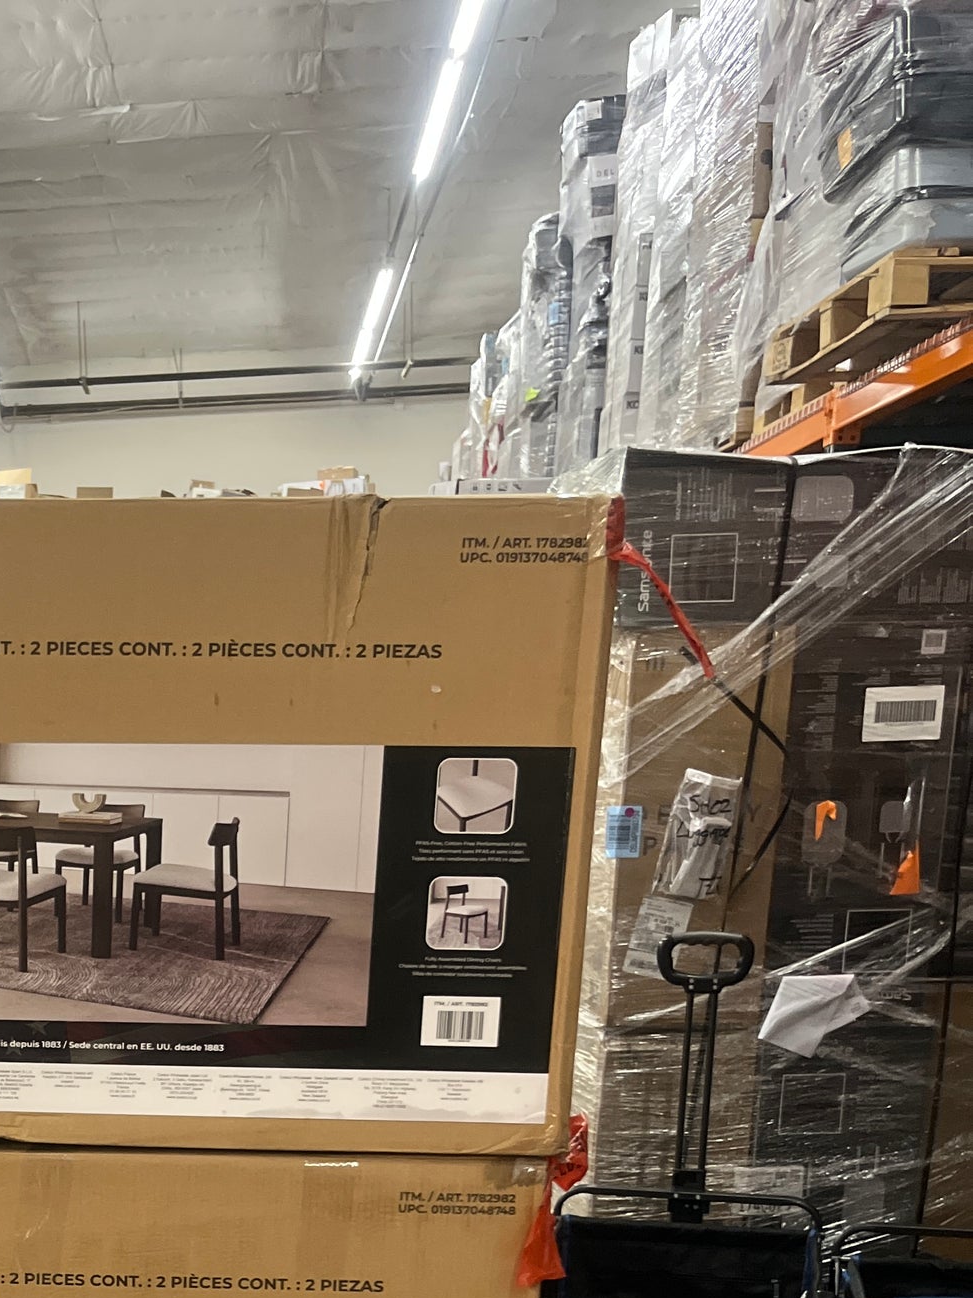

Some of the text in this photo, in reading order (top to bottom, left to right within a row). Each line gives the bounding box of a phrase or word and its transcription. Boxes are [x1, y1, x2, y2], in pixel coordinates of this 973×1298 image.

[462, 538, 489, 549] ITM.
[502, 538, 531, 549] ART.
[460, 552, 492, 563] UPC.
[31, 641, 41, 656] 2
[47, 640, 114, 656] PIECES
[119, 641, 177, 657] CONT.
[192, 643, 202, 657] 2
[209, 639, 277, 658] PIÈCES
[282, 642, 340, 658] CONT.
[356, 643, 366, 658] 2
[373, 643, 442, 659] PIEZAS
[10, 1039, 40, 1049] depuis
[69, 1041, 91, 1049] Sede
[93, 1042, 124, 1050] central
[141, 1042, 154, 1050] EE.
[157, 1043, 173, 1051] UU.
[174, 1043, 202, 1051] desde
[204, 1044, 224, 1052] 1883
[399, 1192, 425, 1202] ITM.
[436, 1193, 463, 1203] ART.
[467, 1194, 516, 1204] 1782982
[398, 1204, 427, 1214] UPC.
[10, 1272, 20, 1284] 2
[25, 1272, 85, 1287] PIECES
[90, 1274, 143, 1288] CONT.
[156, 1275, 166, 1289] 2
[171, 1273, 233, 1290] PIÈCES
[238, 1277, 291, 1290] CONT.
[306, 1279, 316, 1291] 2
[321, 1279, 384, 1293] PIEZAS
